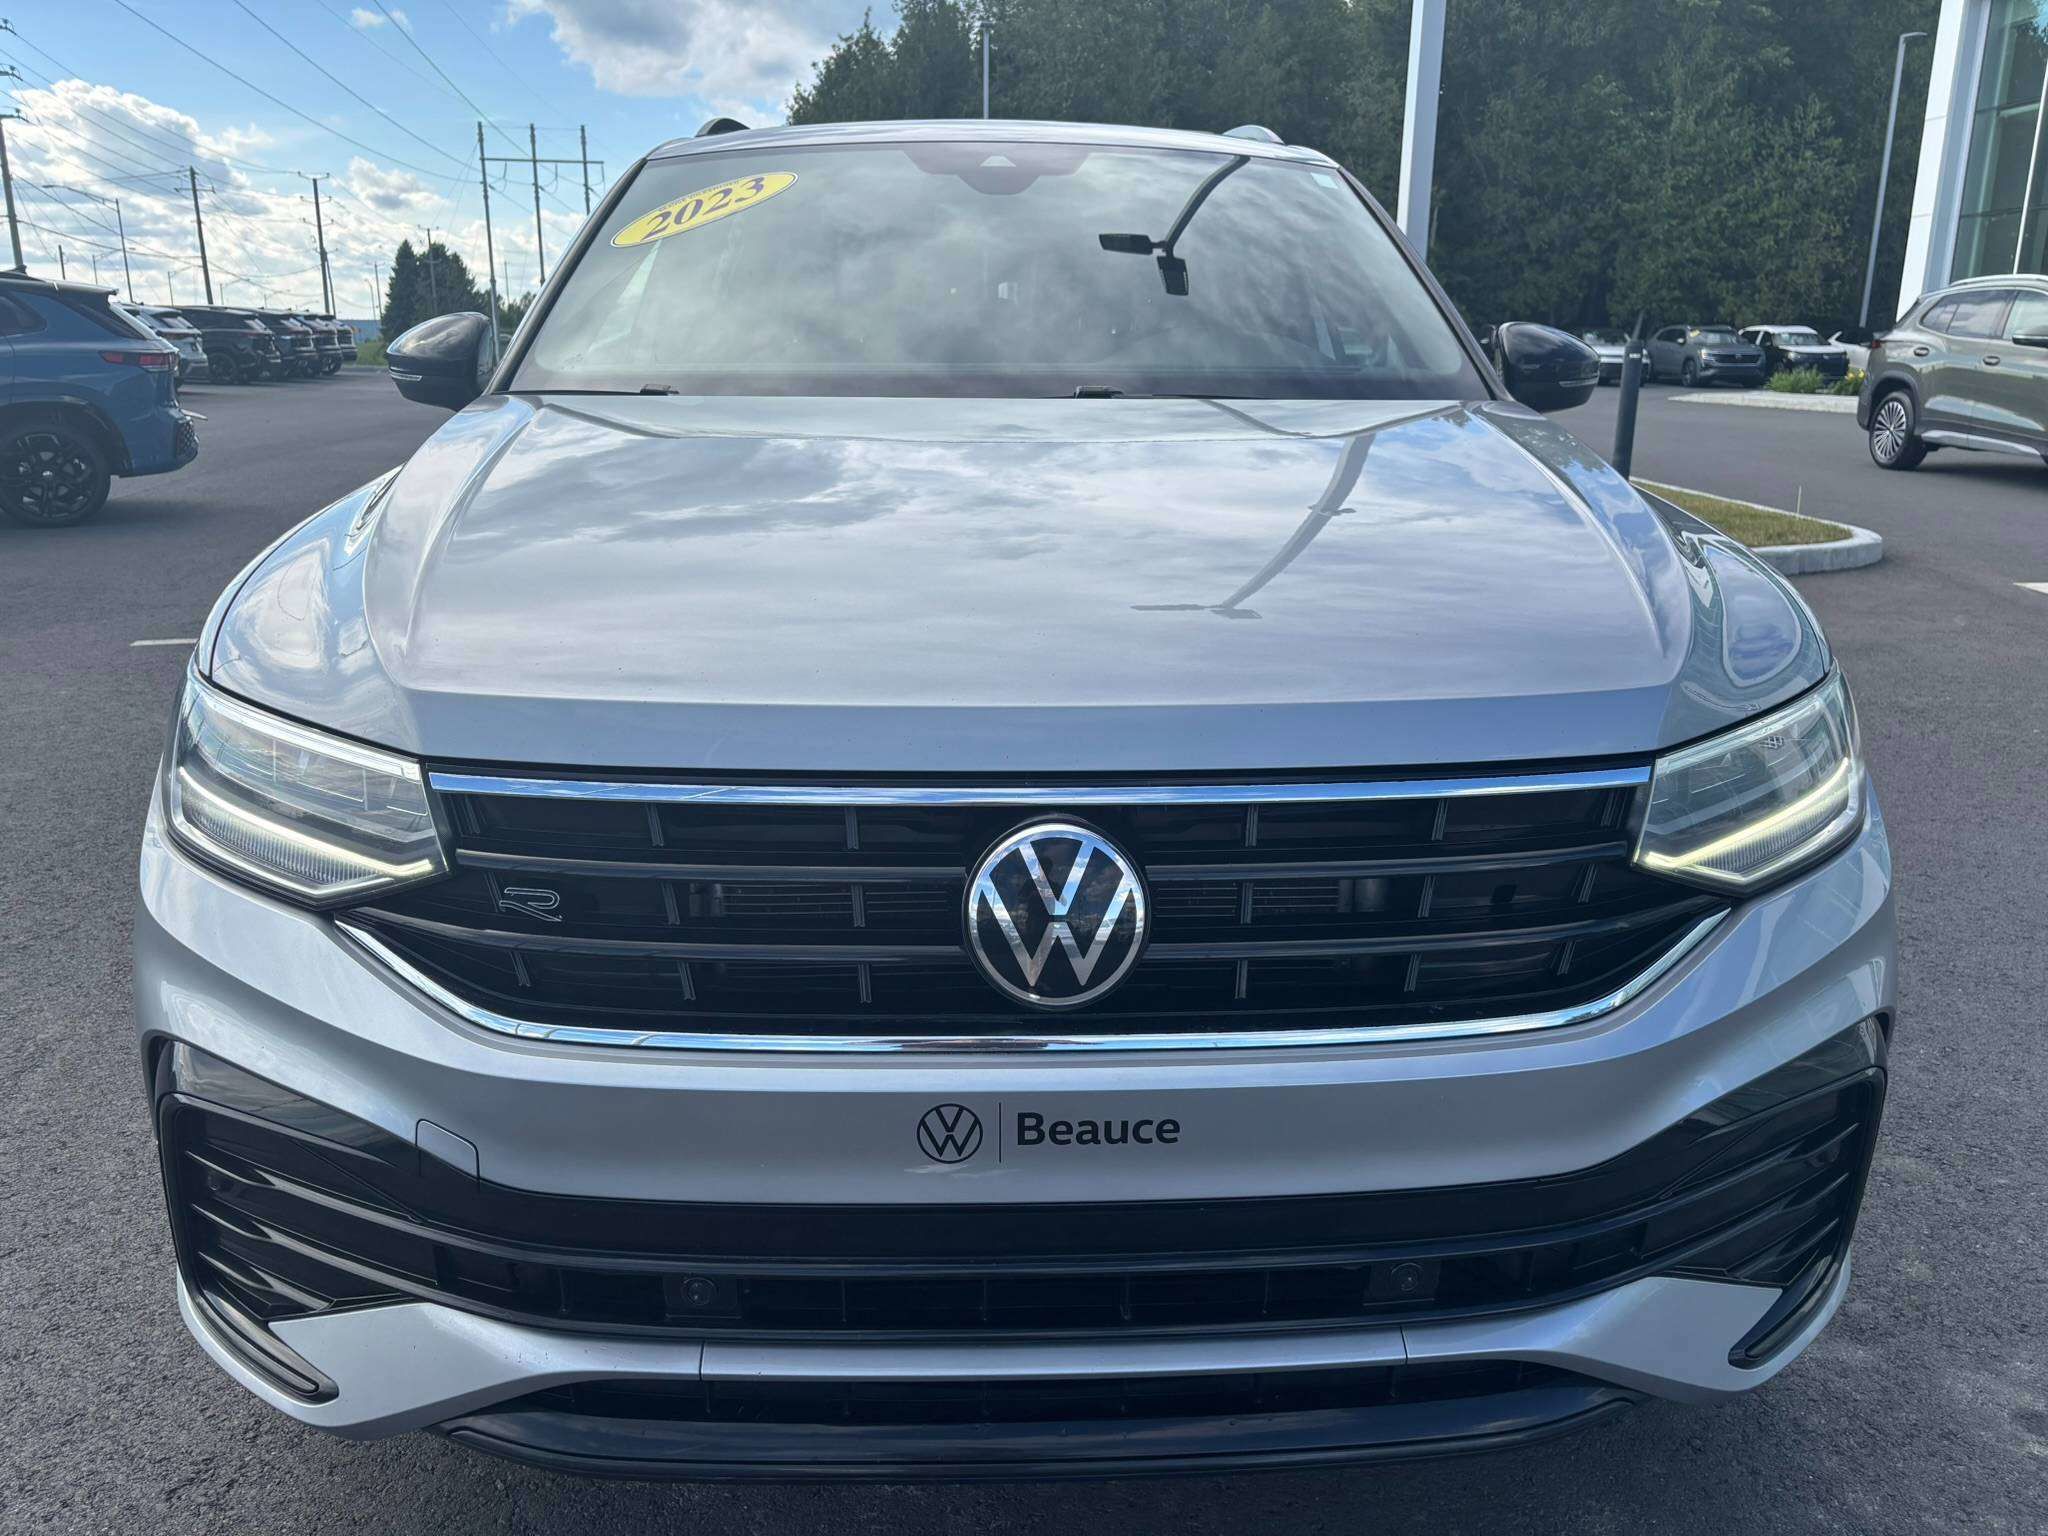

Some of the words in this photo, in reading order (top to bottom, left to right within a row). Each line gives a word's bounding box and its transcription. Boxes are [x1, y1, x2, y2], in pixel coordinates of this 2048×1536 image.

[641, 177, 765, 240] 2023
[499, 887, 562, 922] R
[970, 824, 1143, 1003] VW
[917, 1103, 983, 1164] VW
[1017, 1112, 1181, 1146] Beauce
